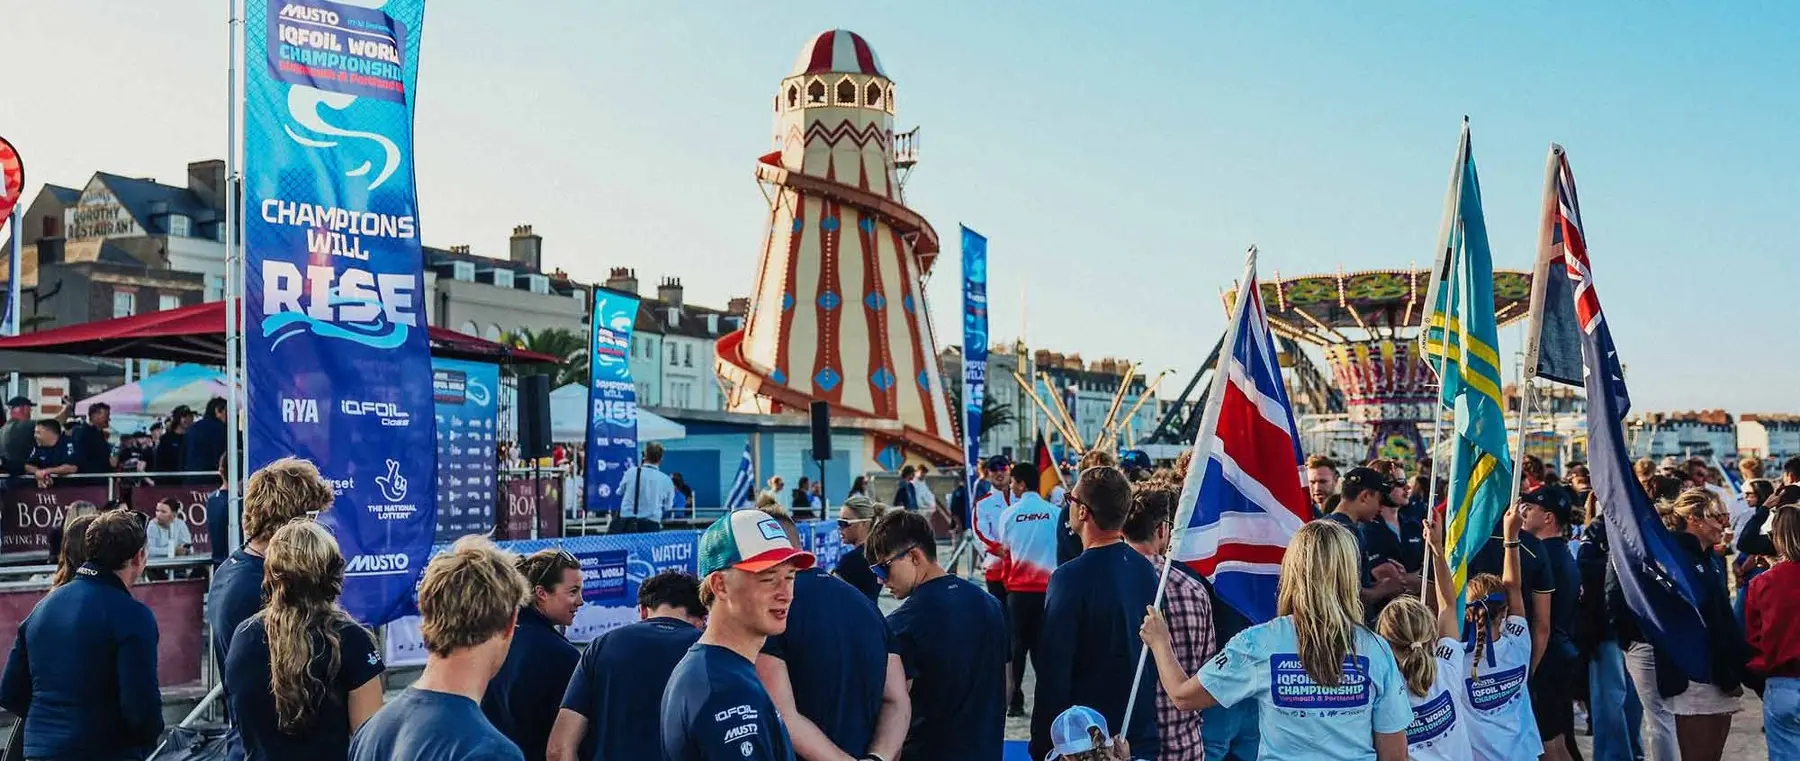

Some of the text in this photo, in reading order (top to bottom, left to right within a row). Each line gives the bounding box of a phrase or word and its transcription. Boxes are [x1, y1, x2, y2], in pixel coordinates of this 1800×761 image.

[280, 3, 339, 26] MUSTO
[261, 198, 415, 239] CHAMPIONS
[307, 229, 369, 261] WILL
[262, 259, 418, 328] RISE
[282, 398, 319, 424] RYA
[593, 398, 638, 420] RISE
[36, 493, 57, 505] THE
[368, 504, 417, 513] THE NATIONAL
[509, 493, 537, 516] BOA
[17, 502, 68, 528] BOA
[378, 512, 409, 520] LOTTERY
[1016, 512, 1050, 523] CHINA
[345, 552, 409, 571] MUSTO
[651, 542, 691, 562] WATCH
[1277, 659, 1303, 669] MUS
[1277, 685, 1365, 697] CHAMPIONSHIP
[1426, 704, 1452, 724] WORLD
